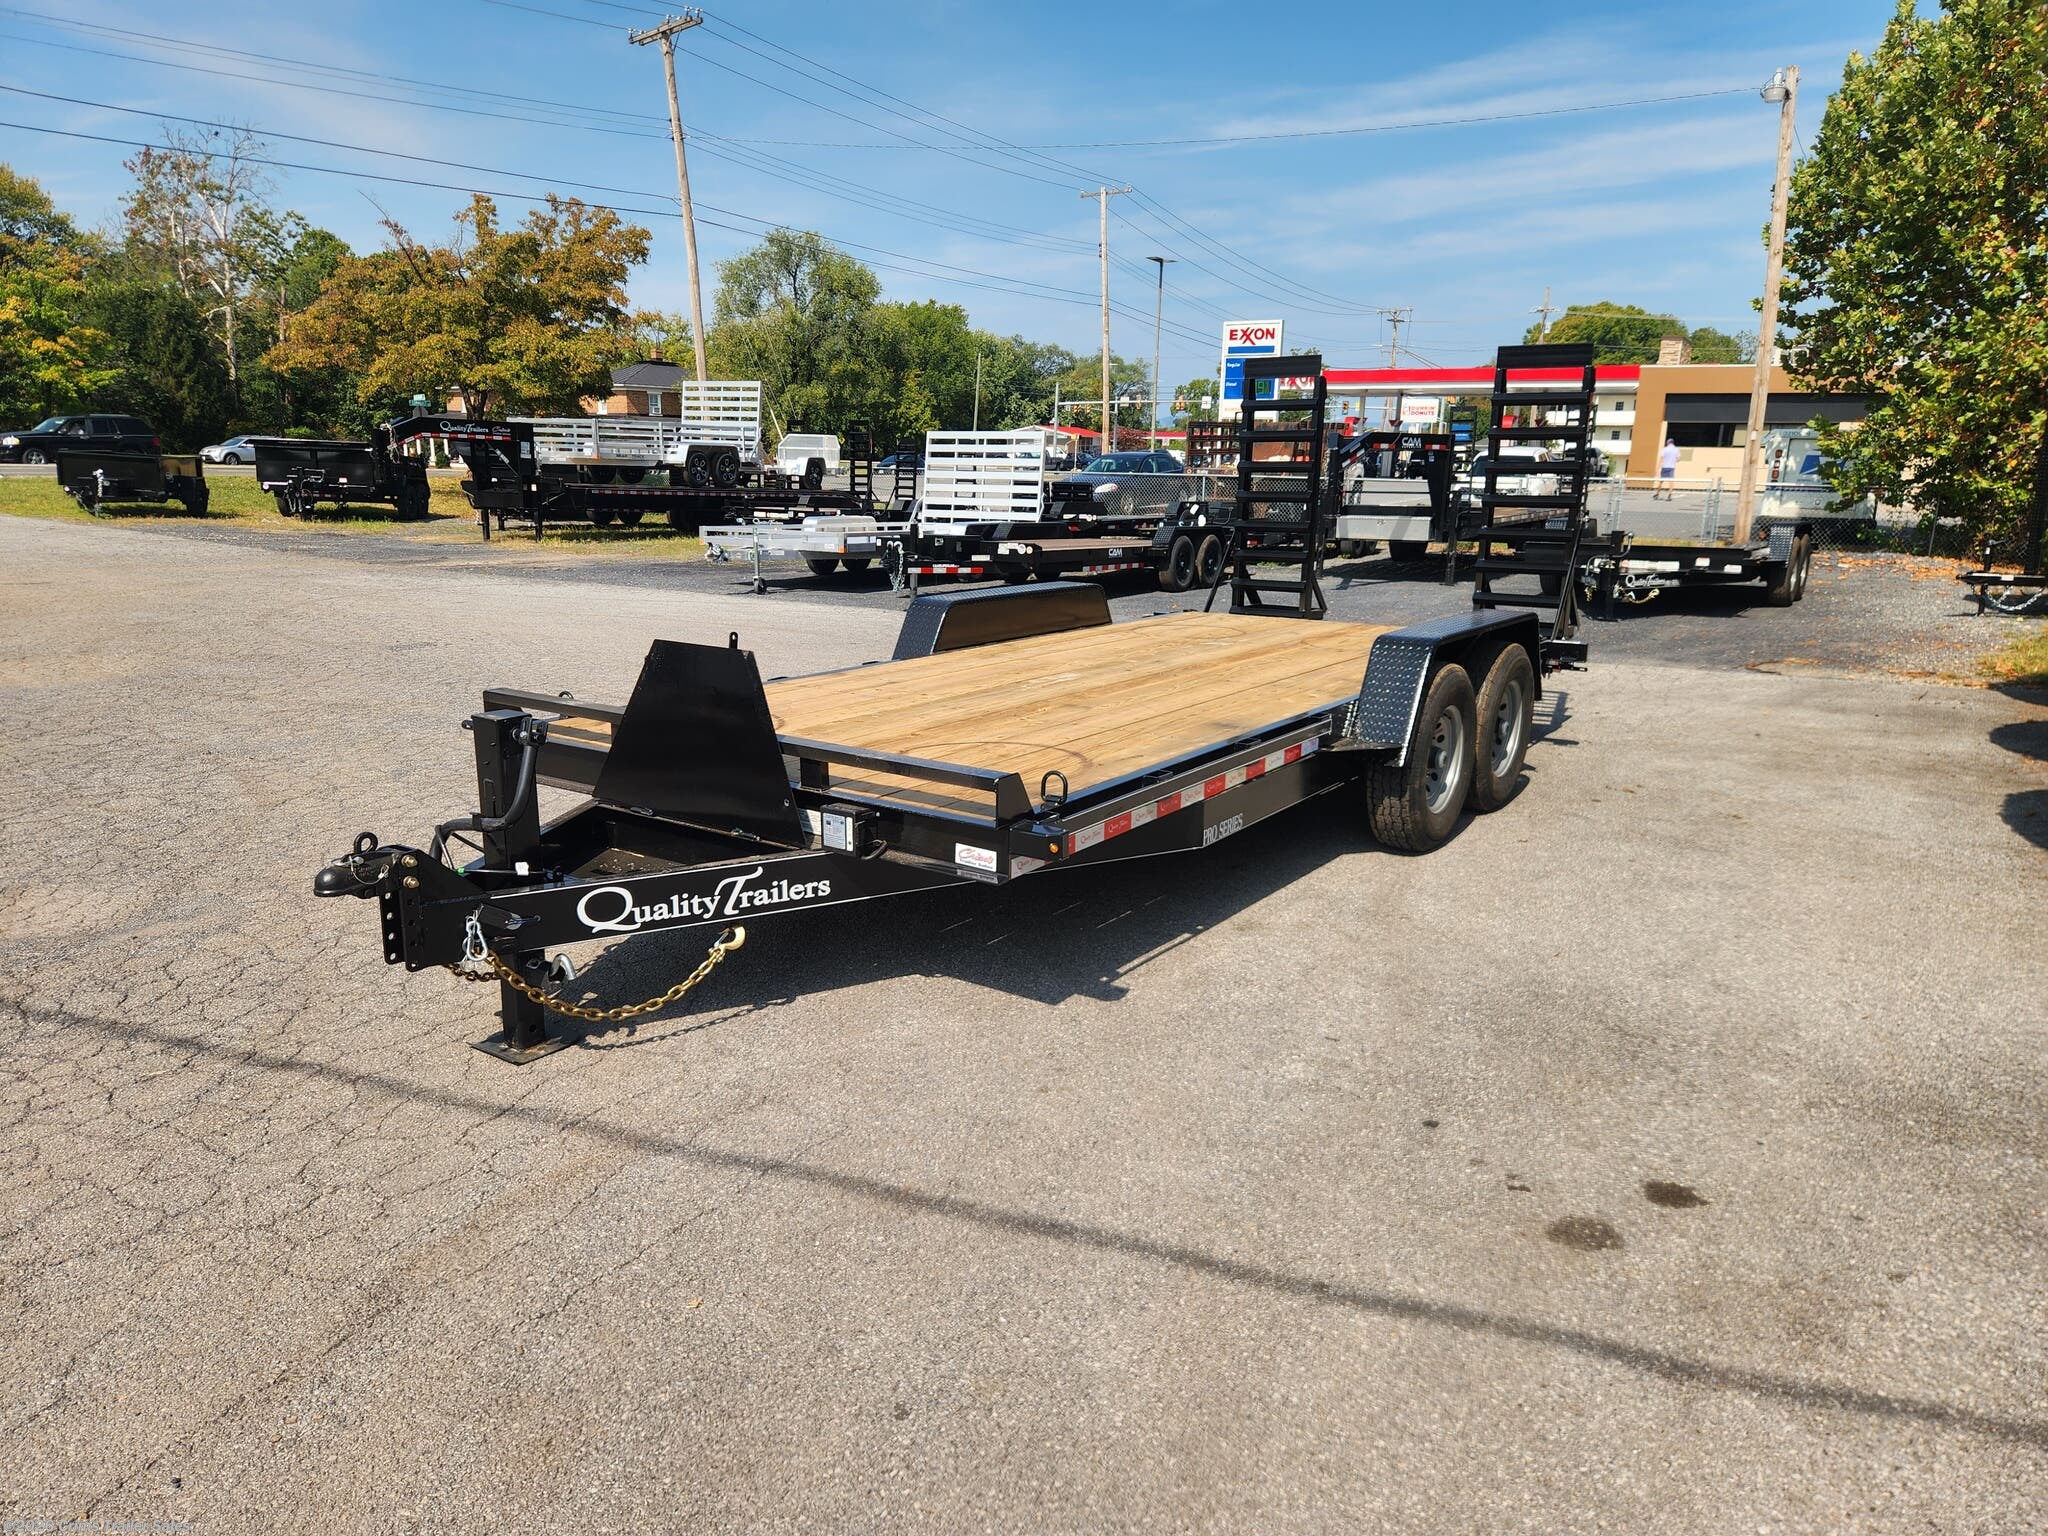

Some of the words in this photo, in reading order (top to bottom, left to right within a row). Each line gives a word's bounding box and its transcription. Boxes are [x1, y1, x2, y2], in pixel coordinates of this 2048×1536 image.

[1229, 327, 1275, 345] EXXON
[440, 420, 466, 433] Quality
[465, 423, 489, 433] Trailers
[1402, 437, 1422, 446] CAM
[1108, 548, 1122, 557] CAM
[1203, 824, 1218, 846] PRO
[1219, 812, 1243, 840] SERIES
[576, 886, 720, 934] Quality
[714, 866, 831, 916] Trailers
